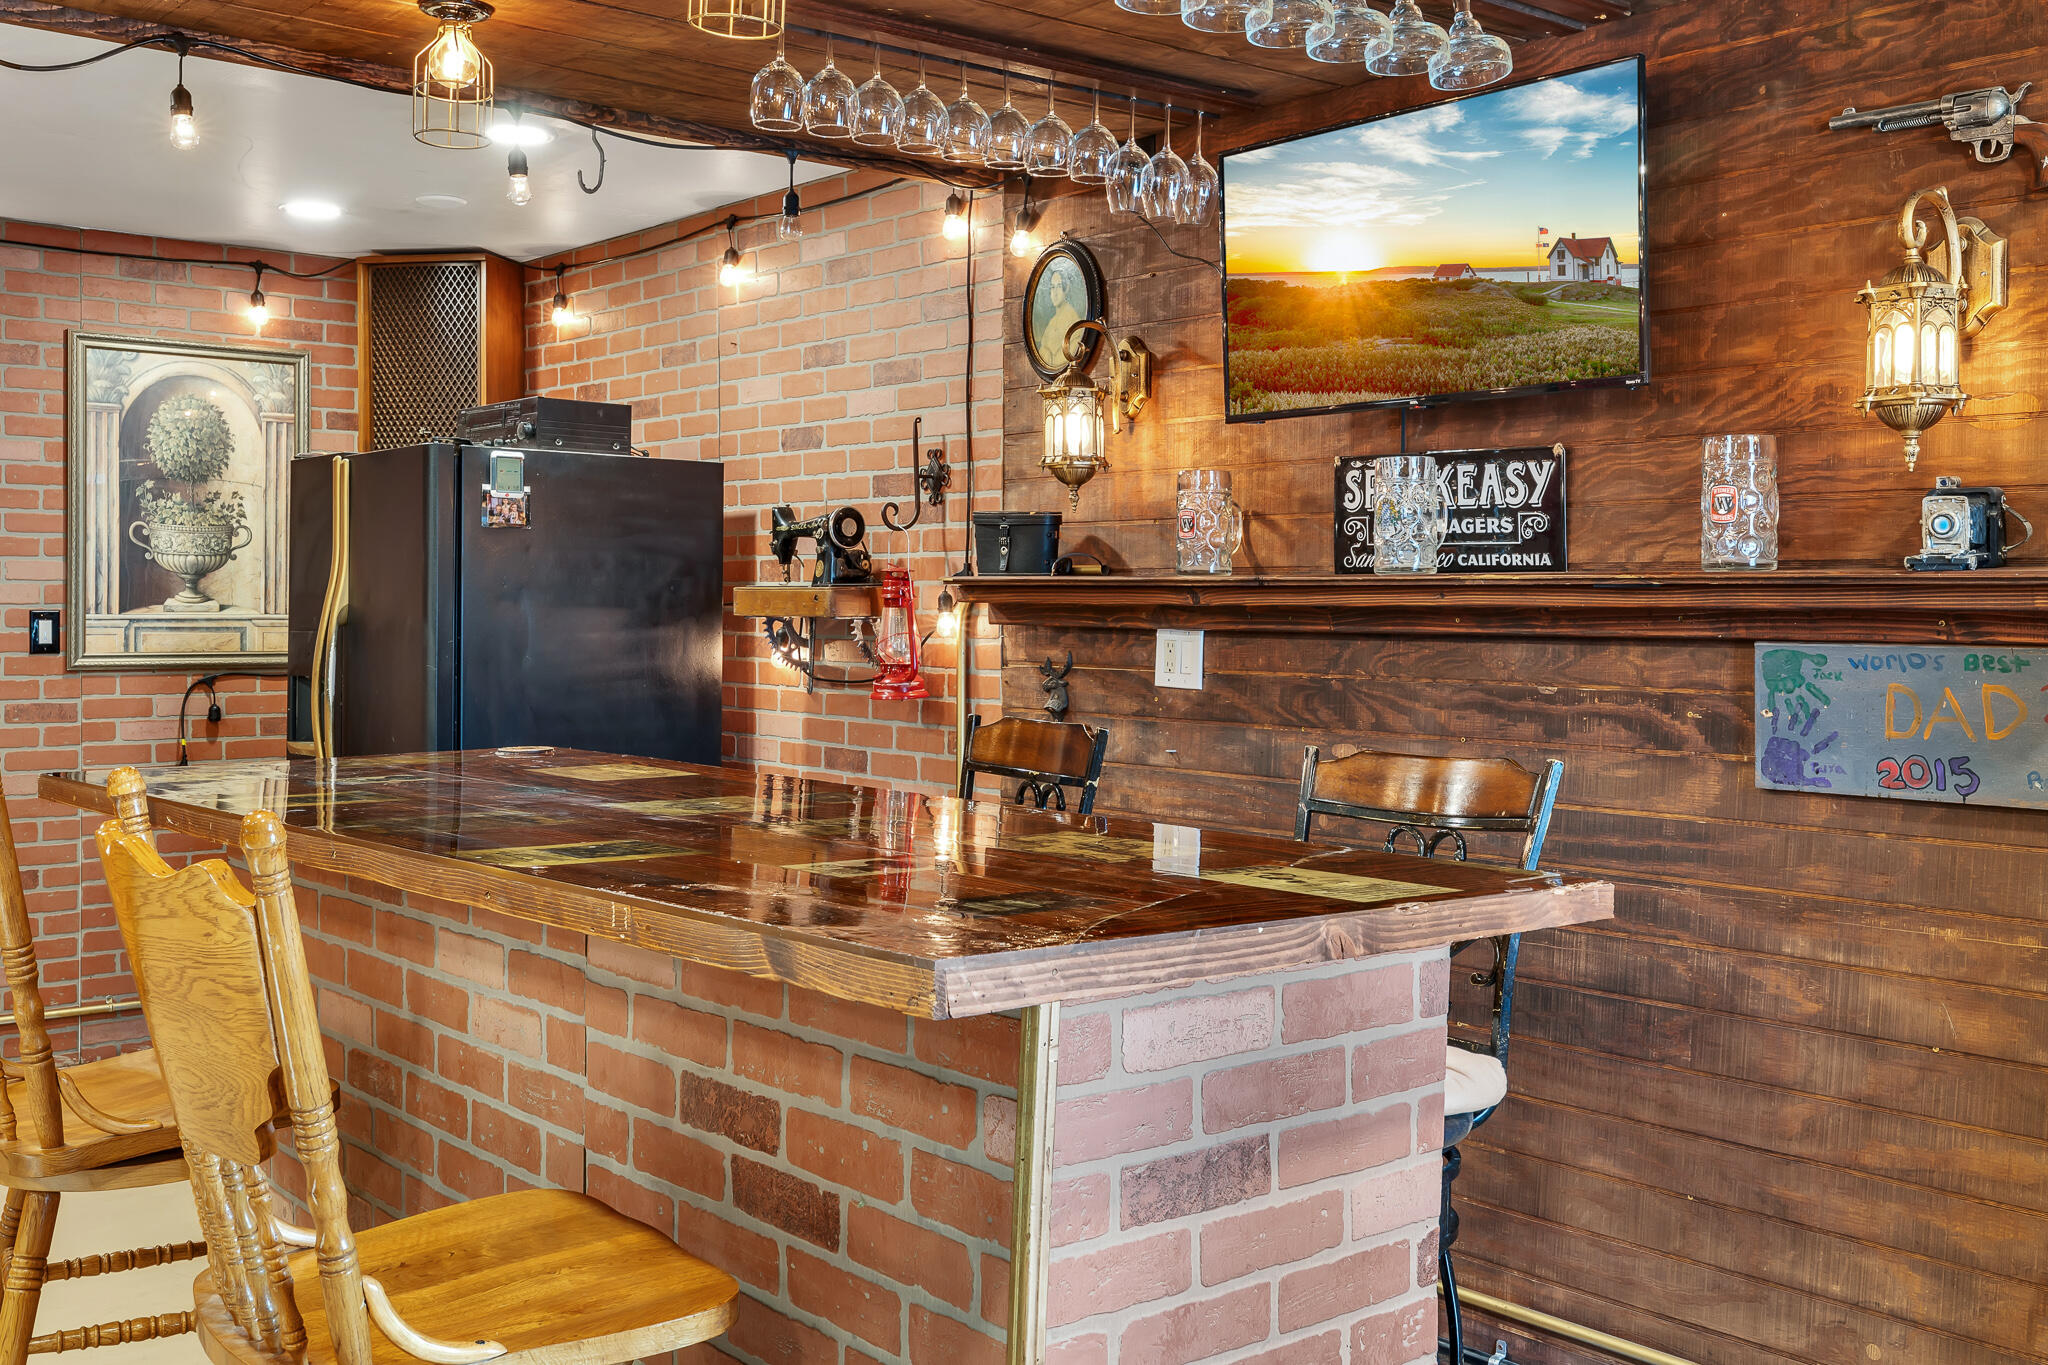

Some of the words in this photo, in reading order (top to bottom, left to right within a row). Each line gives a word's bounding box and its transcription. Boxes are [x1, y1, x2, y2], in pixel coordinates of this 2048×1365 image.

[1343, 542, 1374, 568] San
[1457, 552, 1552, 566] CALIFORNIA
[1884, 683, 2028, 743] DAD
[1876, 754, 1981, 798] 2015
